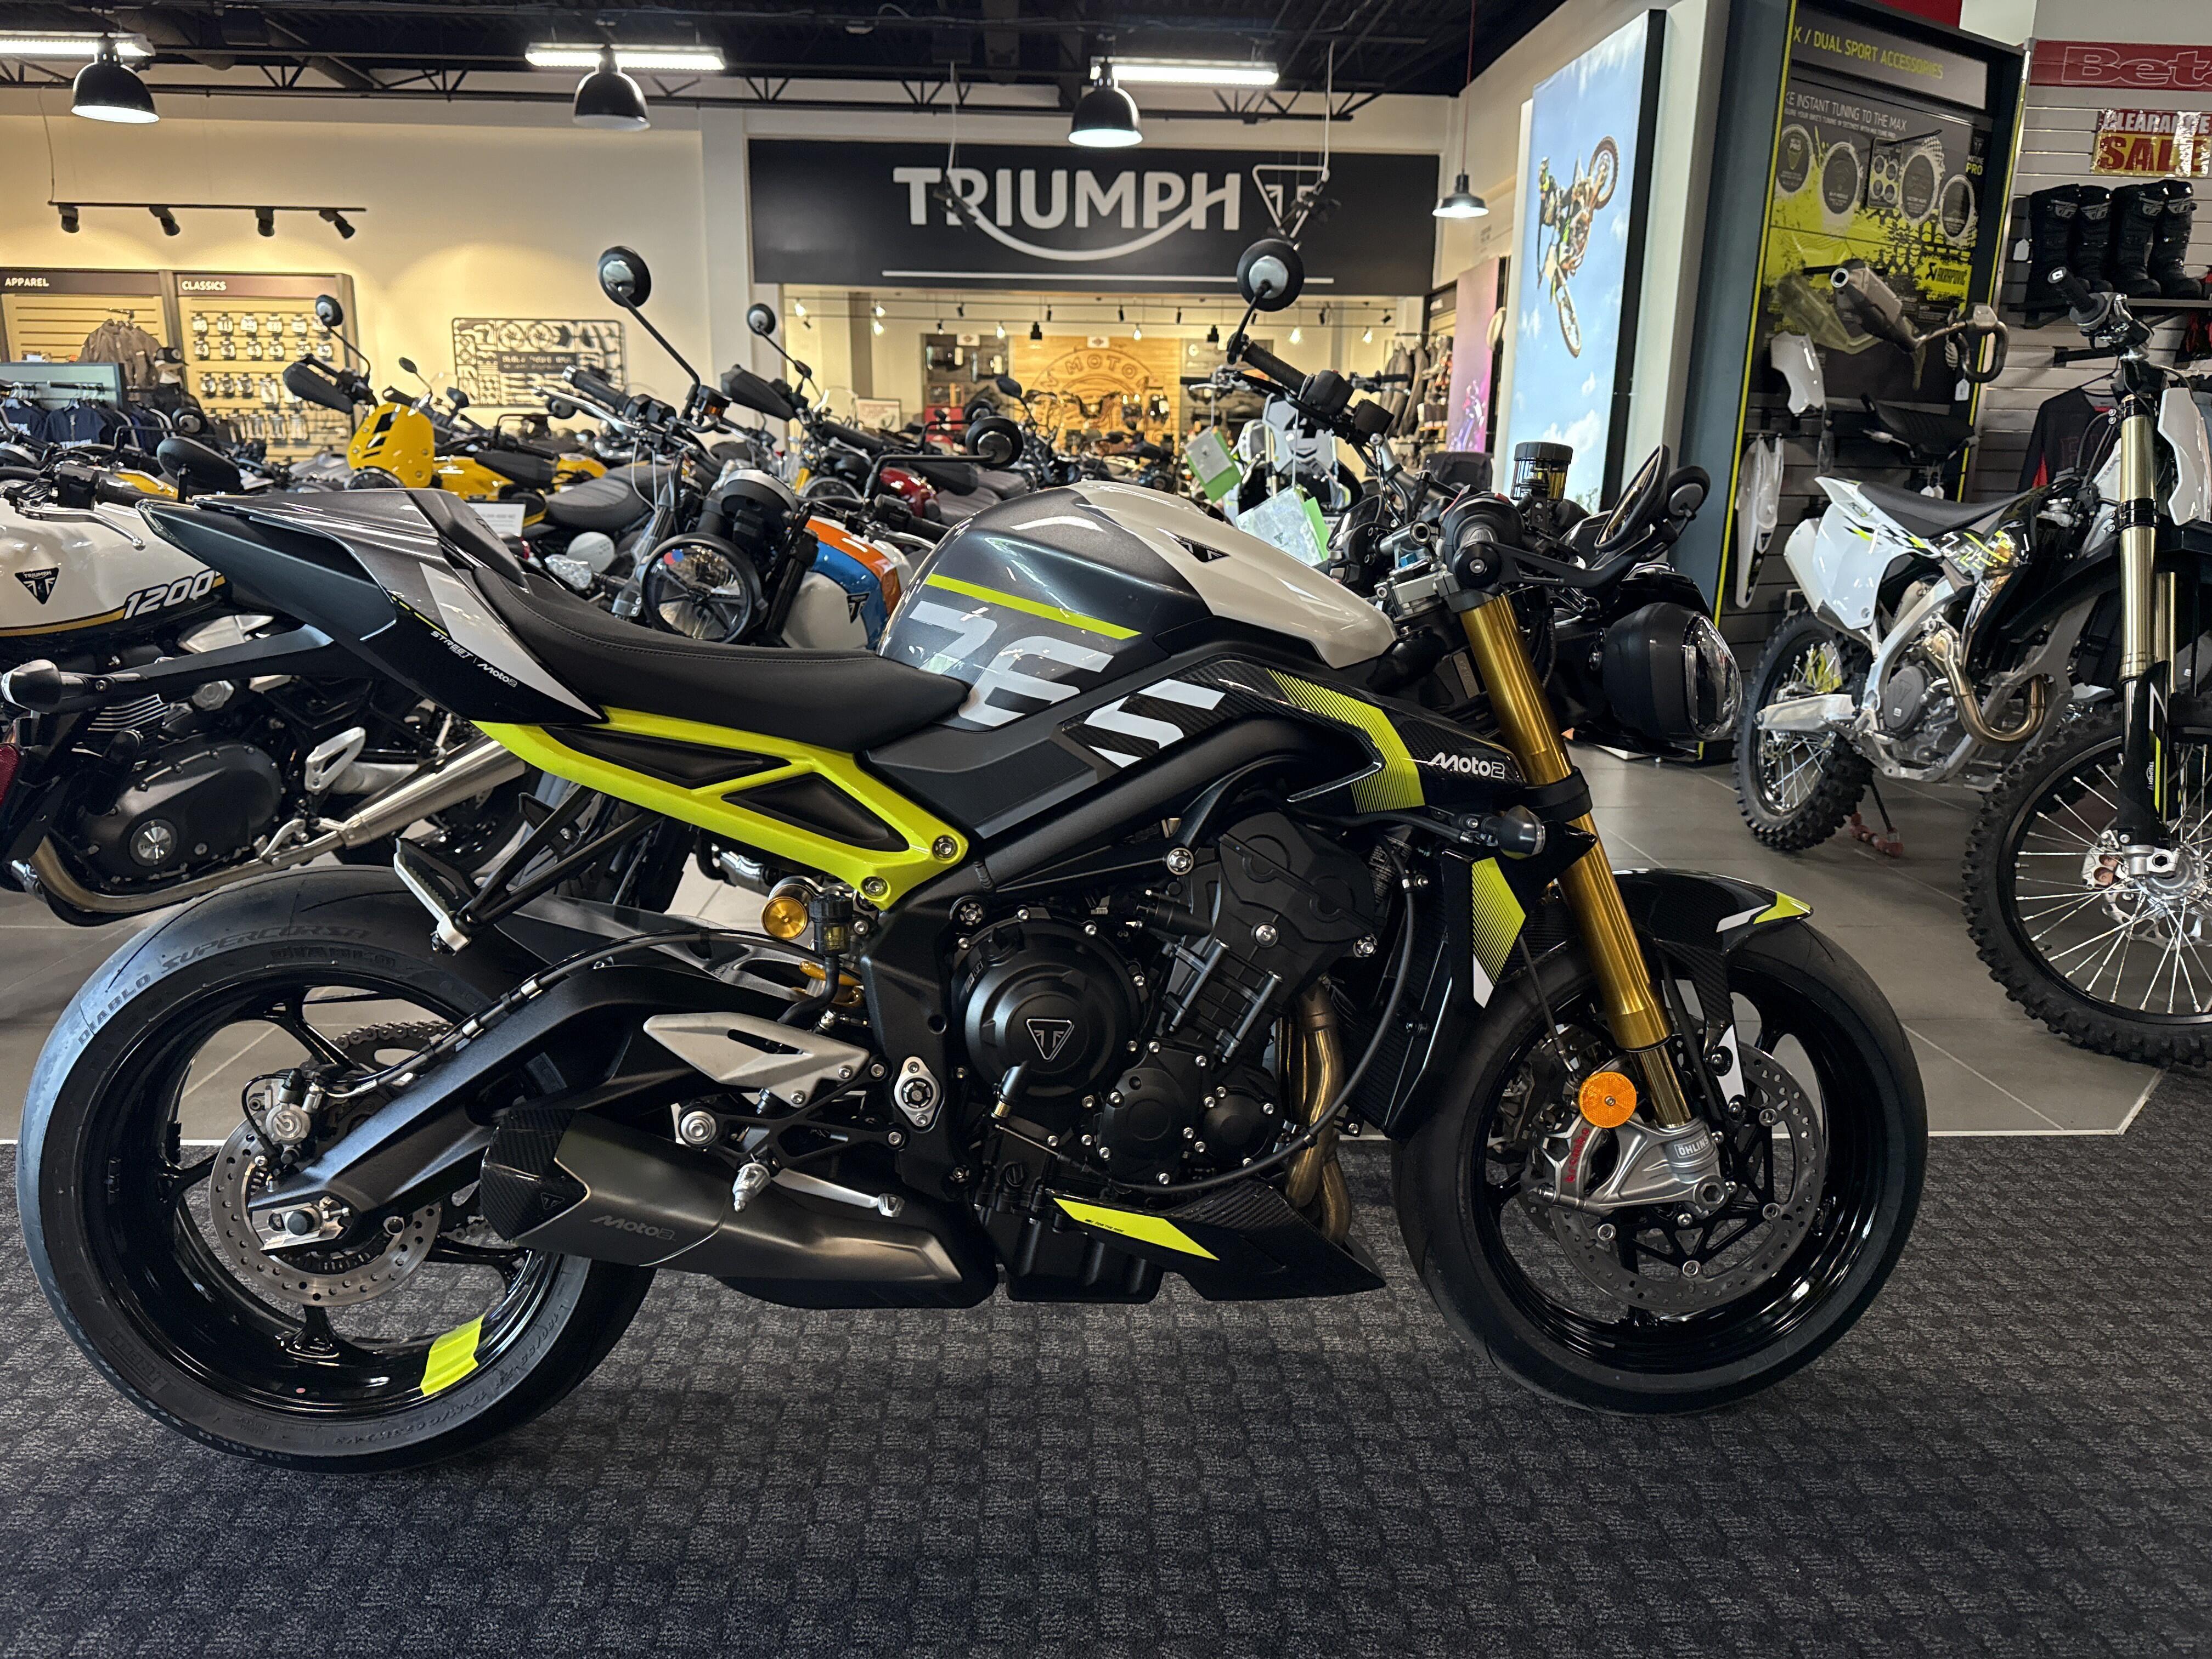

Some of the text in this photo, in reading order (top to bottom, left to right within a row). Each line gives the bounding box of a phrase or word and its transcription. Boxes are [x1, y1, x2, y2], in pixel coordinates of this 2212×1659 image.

[1813, 31, 1842, 53] DUAL
[1844, 39, 1878, 62] SPORT
[1880, 50, 1944, 80] ACCESSORIES
[2062, 46, 2212, 87] Bet
[1797, 94, 1830, 113] INSTANT
[1832, 102, 1860, 120] TUNING
[1863, 109, 1871, 123] TO
[1874, 112, 1888, 127] THE
[1890, 116, 1907, 131] MAX
[2102, 111, 2210, 133] CLEARACE
[1966, 162, 1983, 176] PRO
[2097, 136, 2207, 172] SALE
[893, 166, 1242, 261] TRIUMPH
[4, 278, 49, 287] APPAREL
[182, 280, 227, 291] CLASSICS
[24, 570, 52, 579] TRIUMPH
[124, 569, 216, 620] 1200
[430, 630, 518, 688] STREET Moto2
[1431, 752, 1505, 780] Moto2
[78, 924, 371, 1045] DIABLO SUPERCORSA
[1564, 1127, 1590, 1183] brembo
[1677, 1135, 1709, 1156] ÖHLINS
[589, 1215, 675, 1241] Moto2
